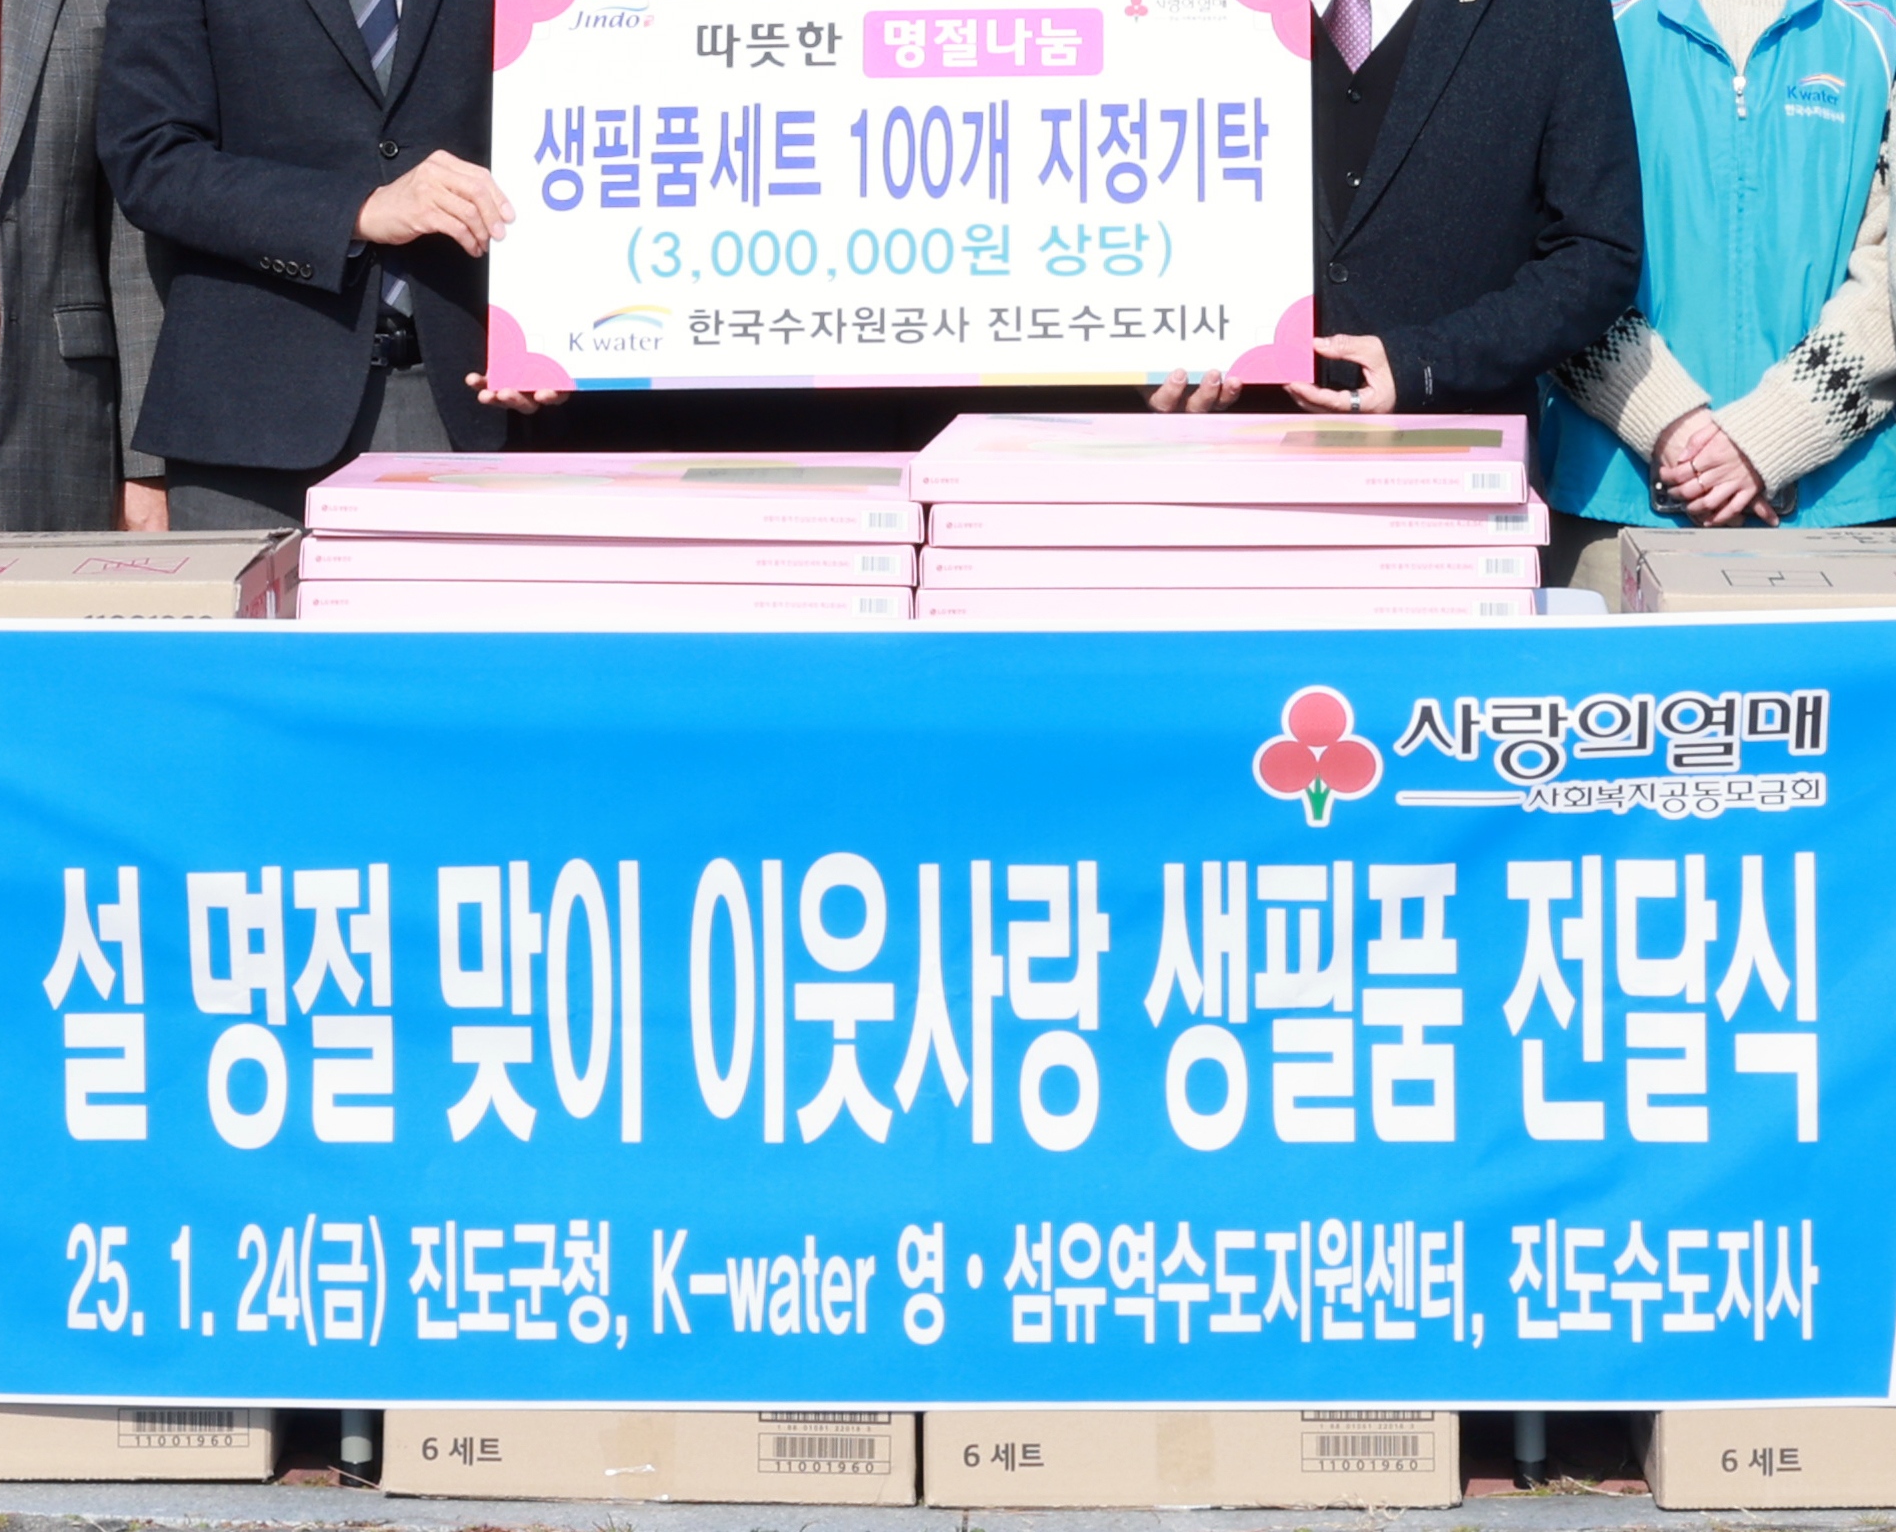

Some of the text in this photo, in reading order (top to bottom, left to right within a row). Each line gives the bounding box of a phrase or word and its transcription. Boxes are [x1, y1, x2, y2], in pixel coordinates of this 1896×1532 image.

[568, 11, 640, 30] Jindo
[697, 18, 1083, 68] 따뜻한 명절나눔
[534, 97, 1269, 211] 생필품세트 100개 지정기탁
[628, 221, 1173, 284] (3,000,000원 상당)
[688, 305, 1229, 346] 한국수자원공사 진도수도지사
[1401, 695, 1822, 780] 사랑의열매
[1528, 778, 1820, 814] 사회복지공동모금회
[44, 852, 1818, 1151] 설 명절 맞이 이웃사랑 생필품 전달식
[67, 1223, 144, 1336] 25.
[171, 1225, 214, 1336] 1.
[237, 1214, 387, 1346] 24(금)
[408, 1219, 629, 1349] 진도군청,
[653, 1229, 876, 1335] K-water
[1509, 1219, 1819, 1343] 진도수도지사
[136, 1435, 233, 1447] 11001960
[421, 1436, 502, 1466] 6 세트
[963, 1442, 1045, 1472] 6 세트
[776, 1461, 874, 1473] 11001960
[1319, 1460, 1418, 1471] 11001960
[1721, 1447, 1802, 1477] 6 세트
